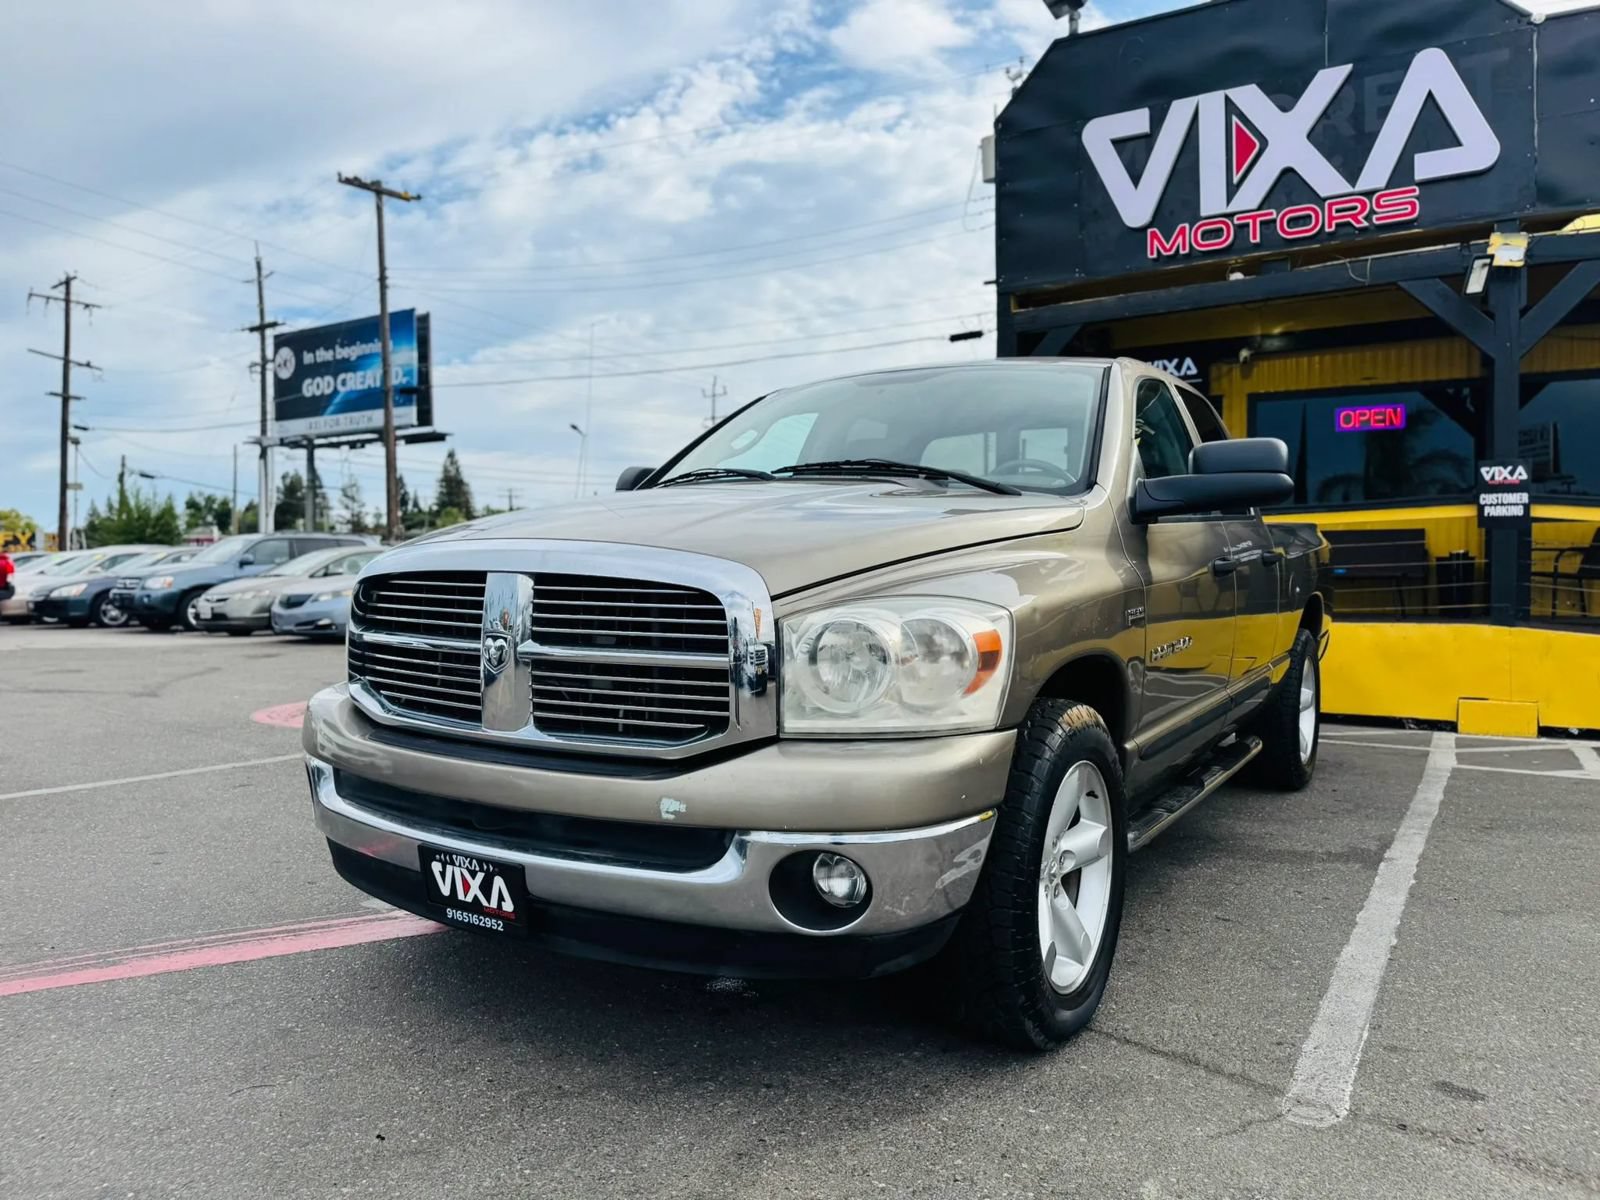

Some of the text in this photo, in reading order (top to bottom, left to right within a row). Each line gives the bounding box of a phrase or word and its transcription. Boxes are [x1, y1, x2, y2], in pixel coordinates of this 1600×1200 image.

[1081, 47, 1500, 229] VIXA
[1147, 186, 1420, 259] MOTORS
[303, 351, 315, 366] In
[316, 346, 334, 364] the
[335, 338, 394, 361] beginni
[302, 368, 408, 398] GOD CREATD.
[1340, 407, 1401, 429] OPEN
[1480, 465, 1528, 481] VIXA
[1479, 492, 1529, 505] CUSTOMER
[1484, 505, 1524, 517] PARKING
[452, 854, 480, 871] VIXA
[431, 860, 515, 912] VIXA
[446, 907, 504, 931] 9165162952
